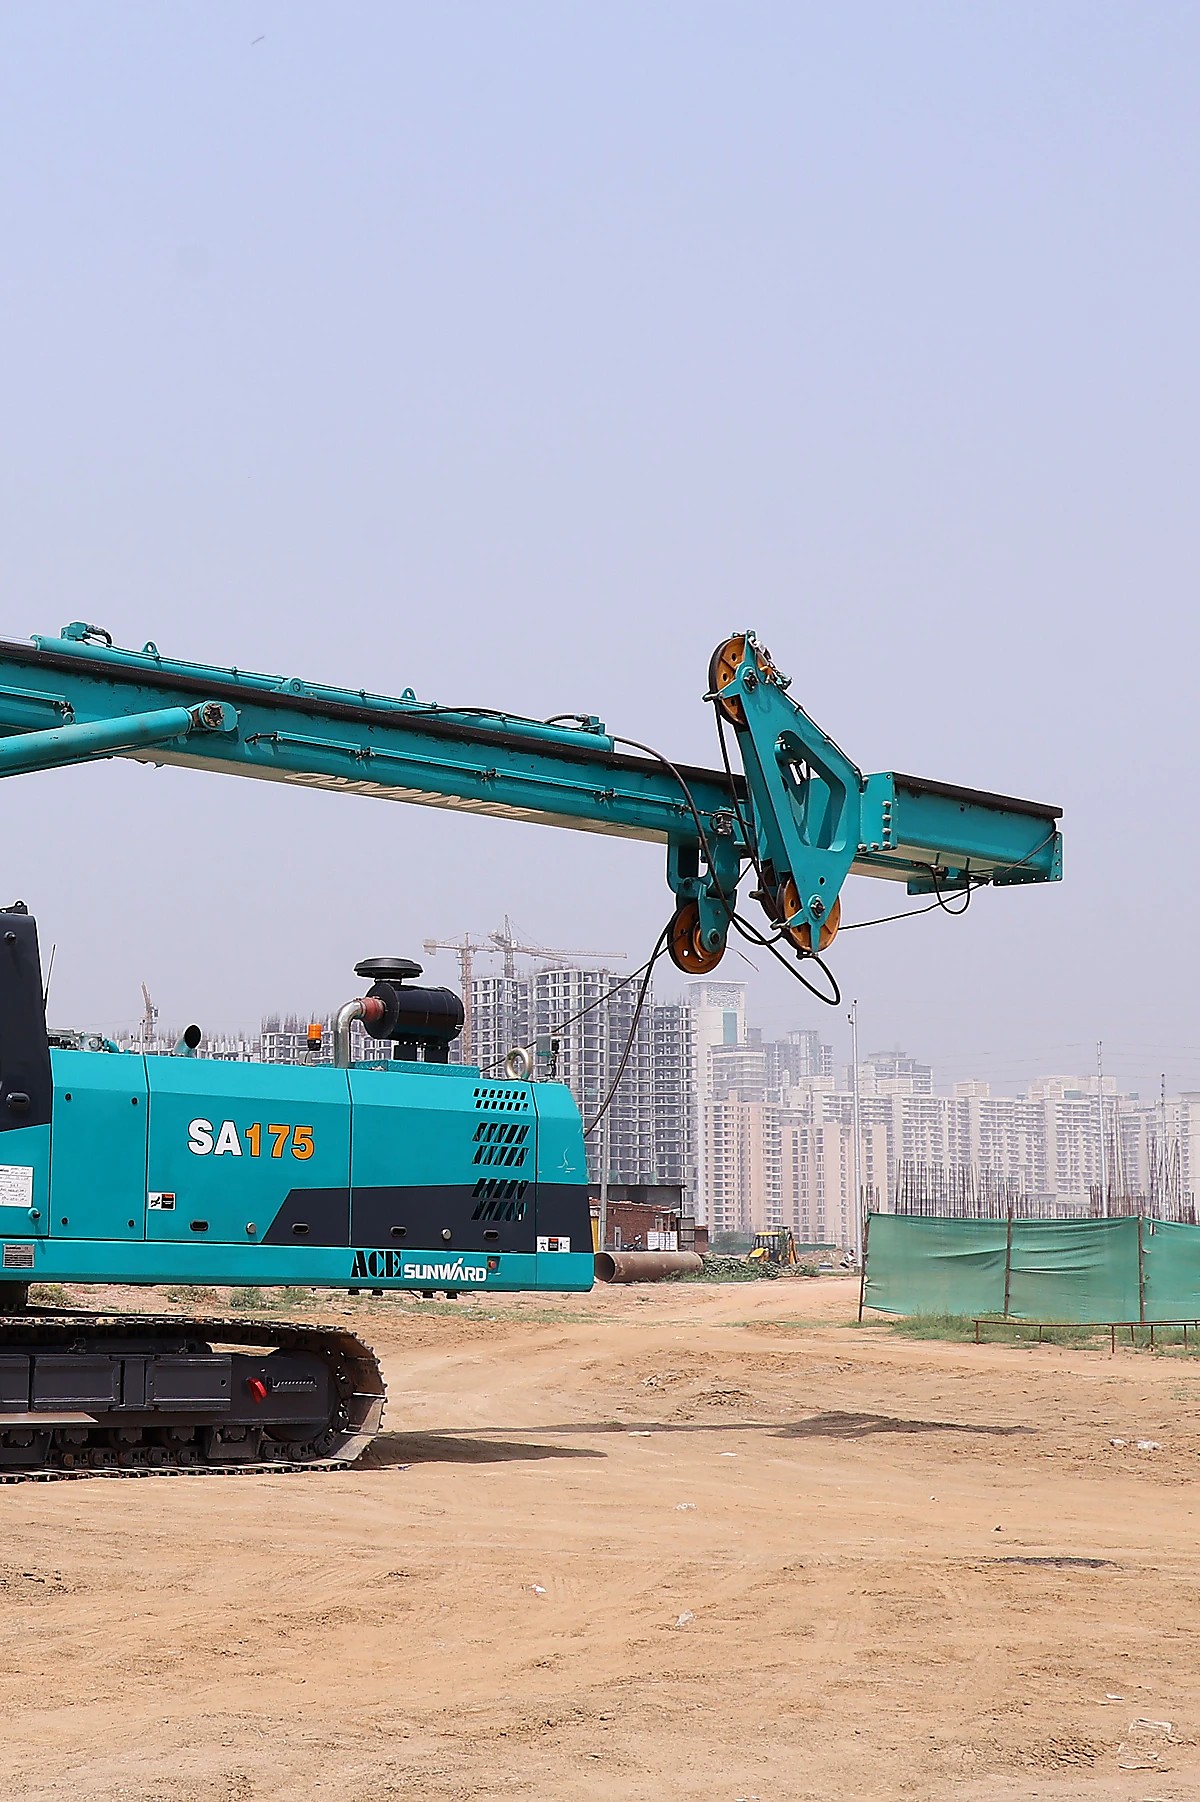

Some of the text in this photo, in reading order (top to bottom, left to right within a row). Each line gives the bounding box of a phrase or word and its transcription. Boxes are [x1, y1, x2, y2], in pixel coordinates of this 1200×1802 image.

[187, 1117, 315, 1160] SA175
[350, 1250, 487, 1282] ACE SUNWARD
